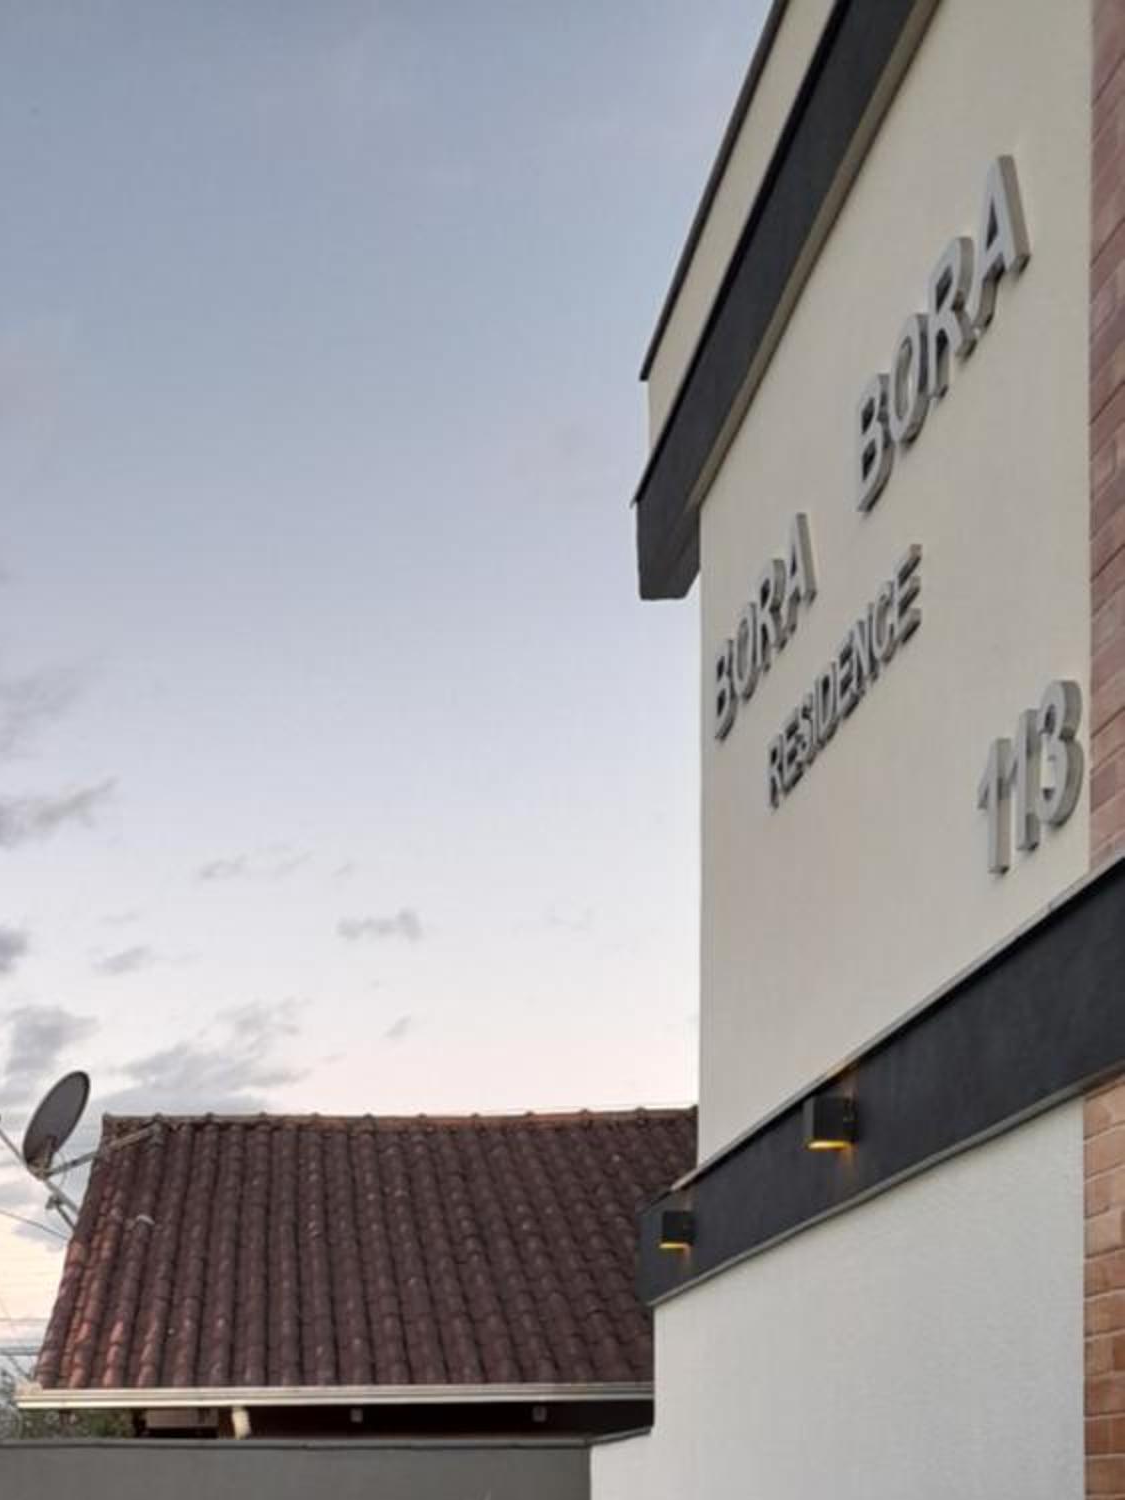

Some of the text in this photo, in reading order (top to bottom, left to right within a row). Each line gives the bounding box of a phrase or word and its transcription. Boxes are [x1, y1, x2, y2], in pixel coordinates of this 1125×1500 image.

[715, 154, 1031, 742] BORA BORA
[768, 544, 922, 808] RESIDENCE
[978, 679, 1083, 875] 113
